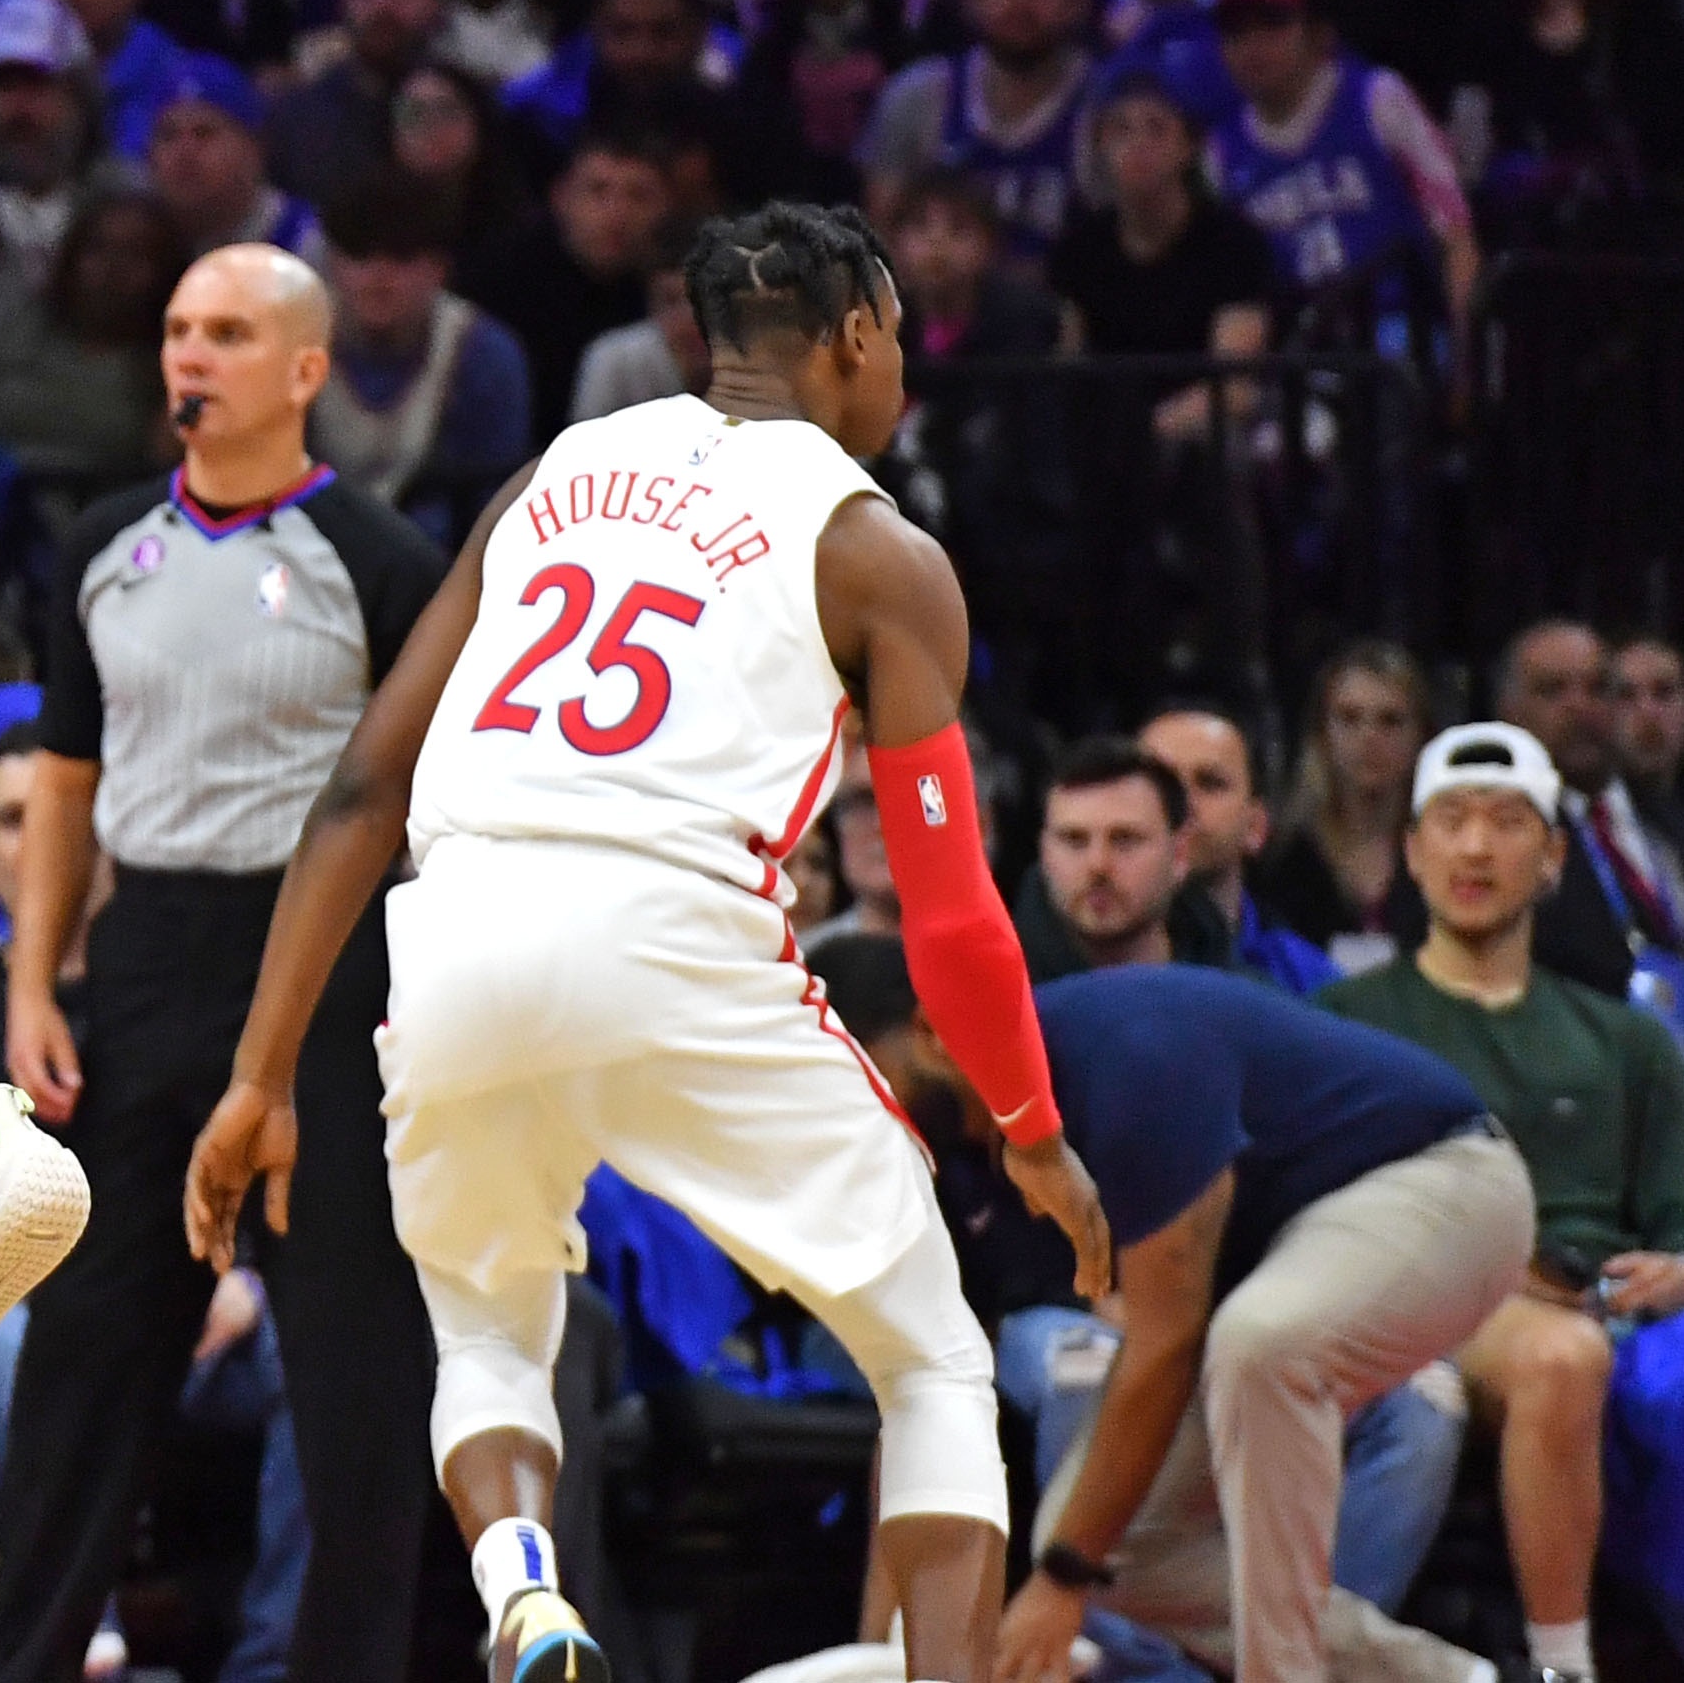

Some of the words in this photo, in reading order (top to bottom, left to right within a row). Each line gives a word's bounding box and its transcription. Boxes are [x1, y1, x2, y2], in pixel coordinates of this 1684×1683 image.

[526, 470, 712, 545] HOUSE
[690, 513, 770, 593] JR.
[471, 561, 706, 756] 25
